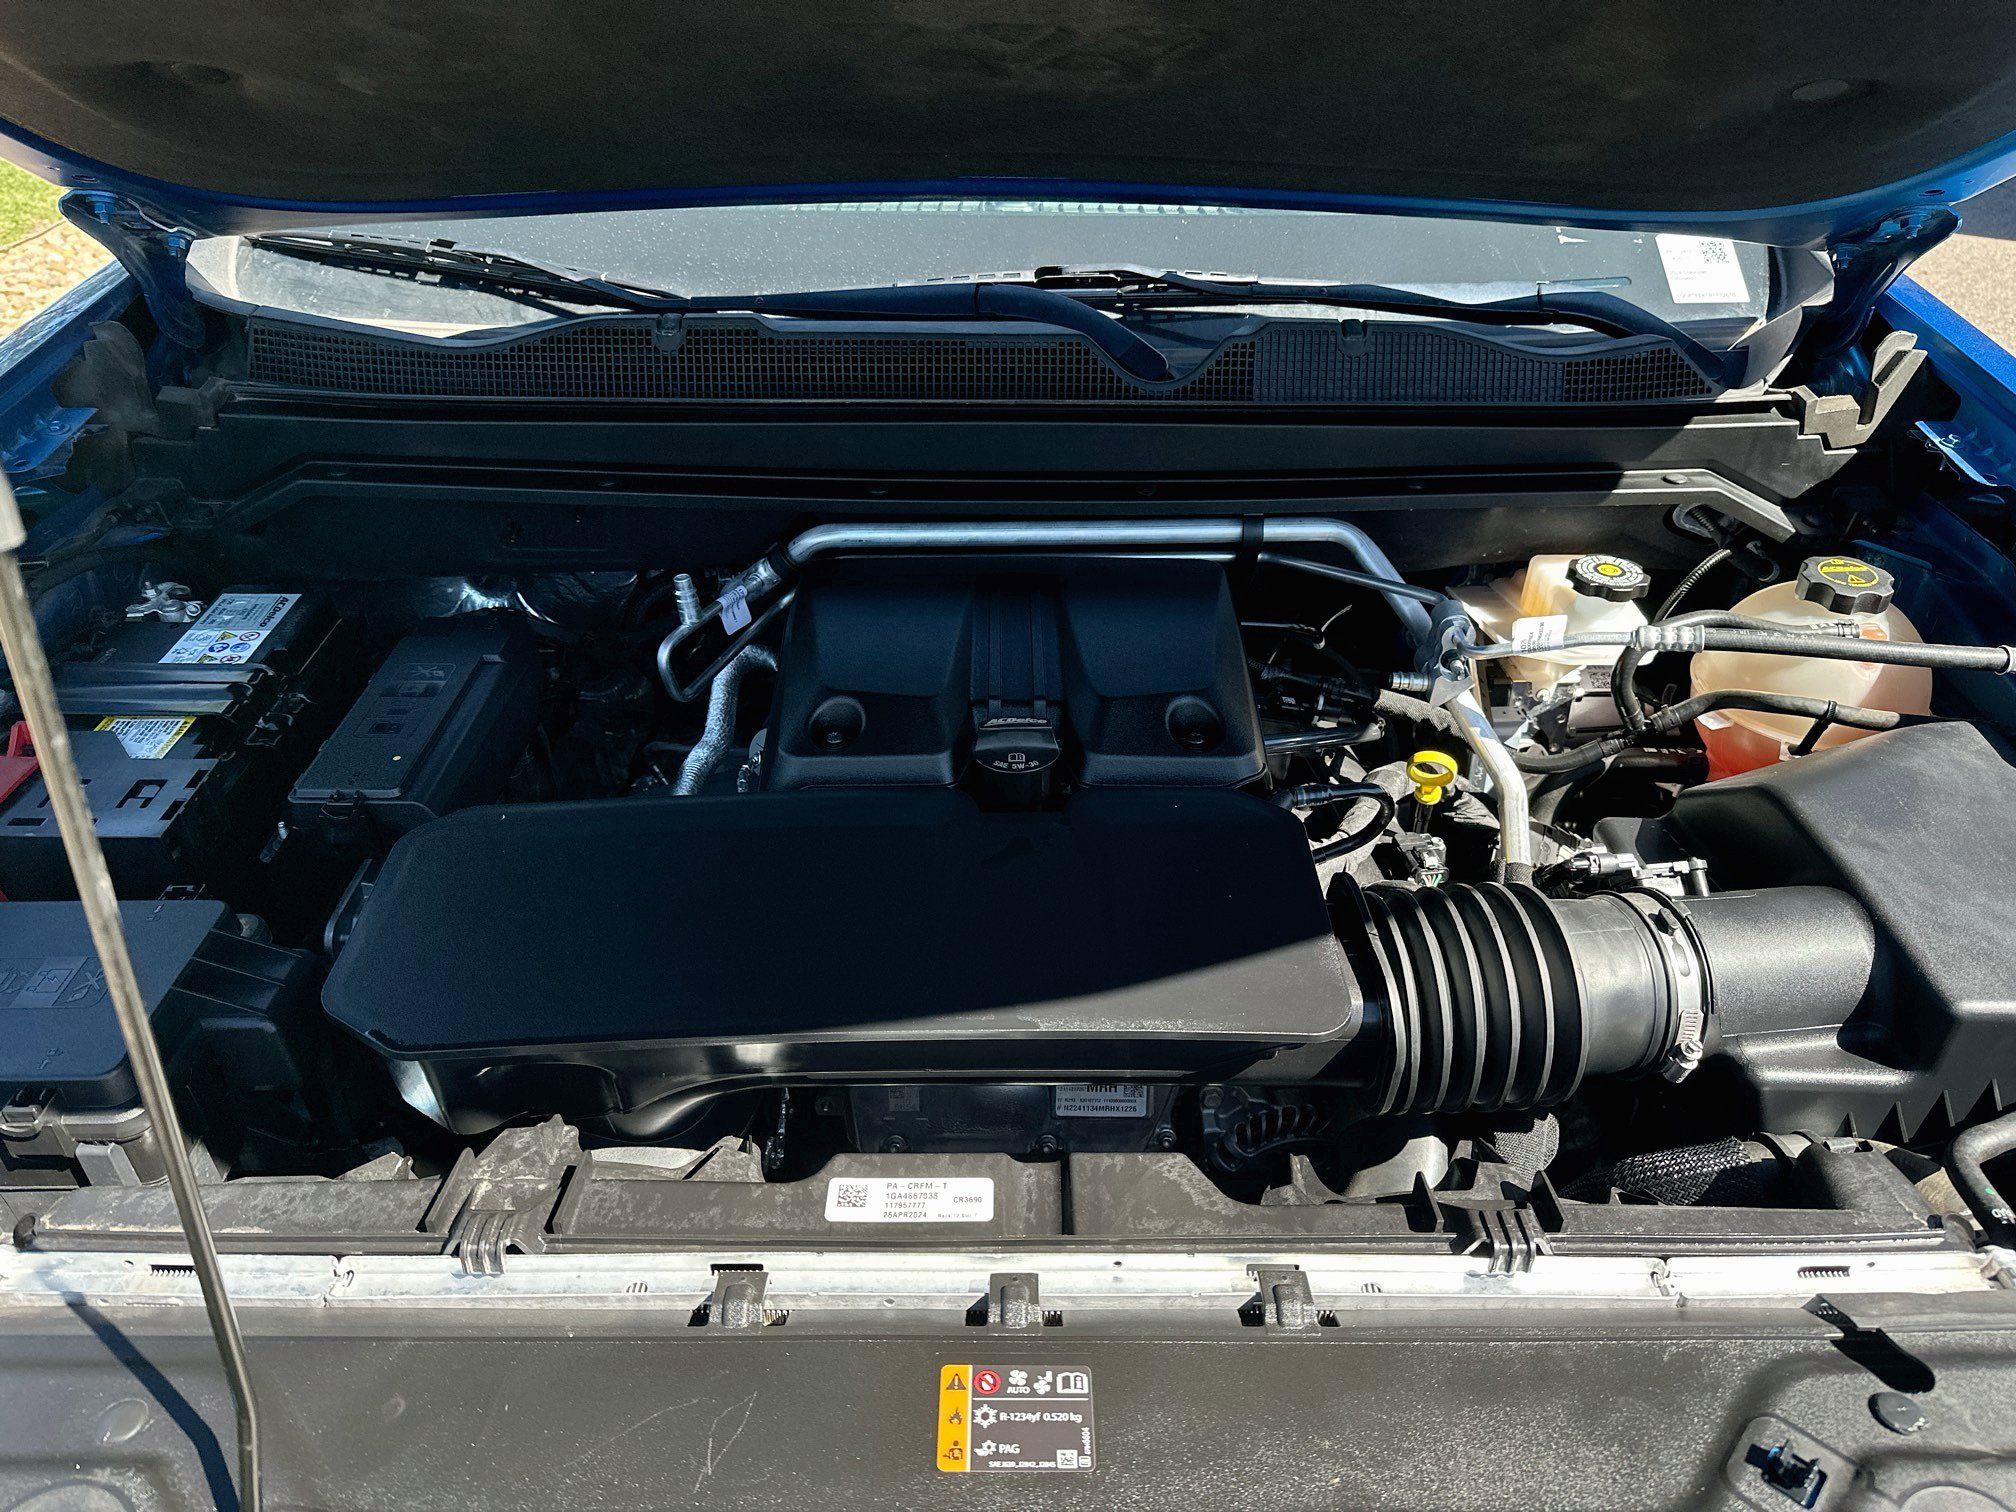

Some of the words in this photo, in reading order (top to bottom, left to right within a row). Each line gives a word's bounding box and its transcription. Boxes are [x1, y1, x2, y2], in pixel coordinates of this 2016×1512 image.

[260, 596, 290, 628] ACDelco
[984, 717, 1048, 727] ACDelco
[993, 760, 1009, 769] SAE
[1012, 760, 1040, 770] 5W-30
[953, 1196, 983, 1204] CR3690
[883, 1211, 927, 1219] 26APR2024
[1007, 1386, 1031, 1394] AUTO
[999, 1412, 1040, 1424] R-1234yf
[1043, 1412, 1069, 1422] 0.520
[1070, 1412, 1083, 1424] kg
[998, 1443, 1021, 1454] PAG
